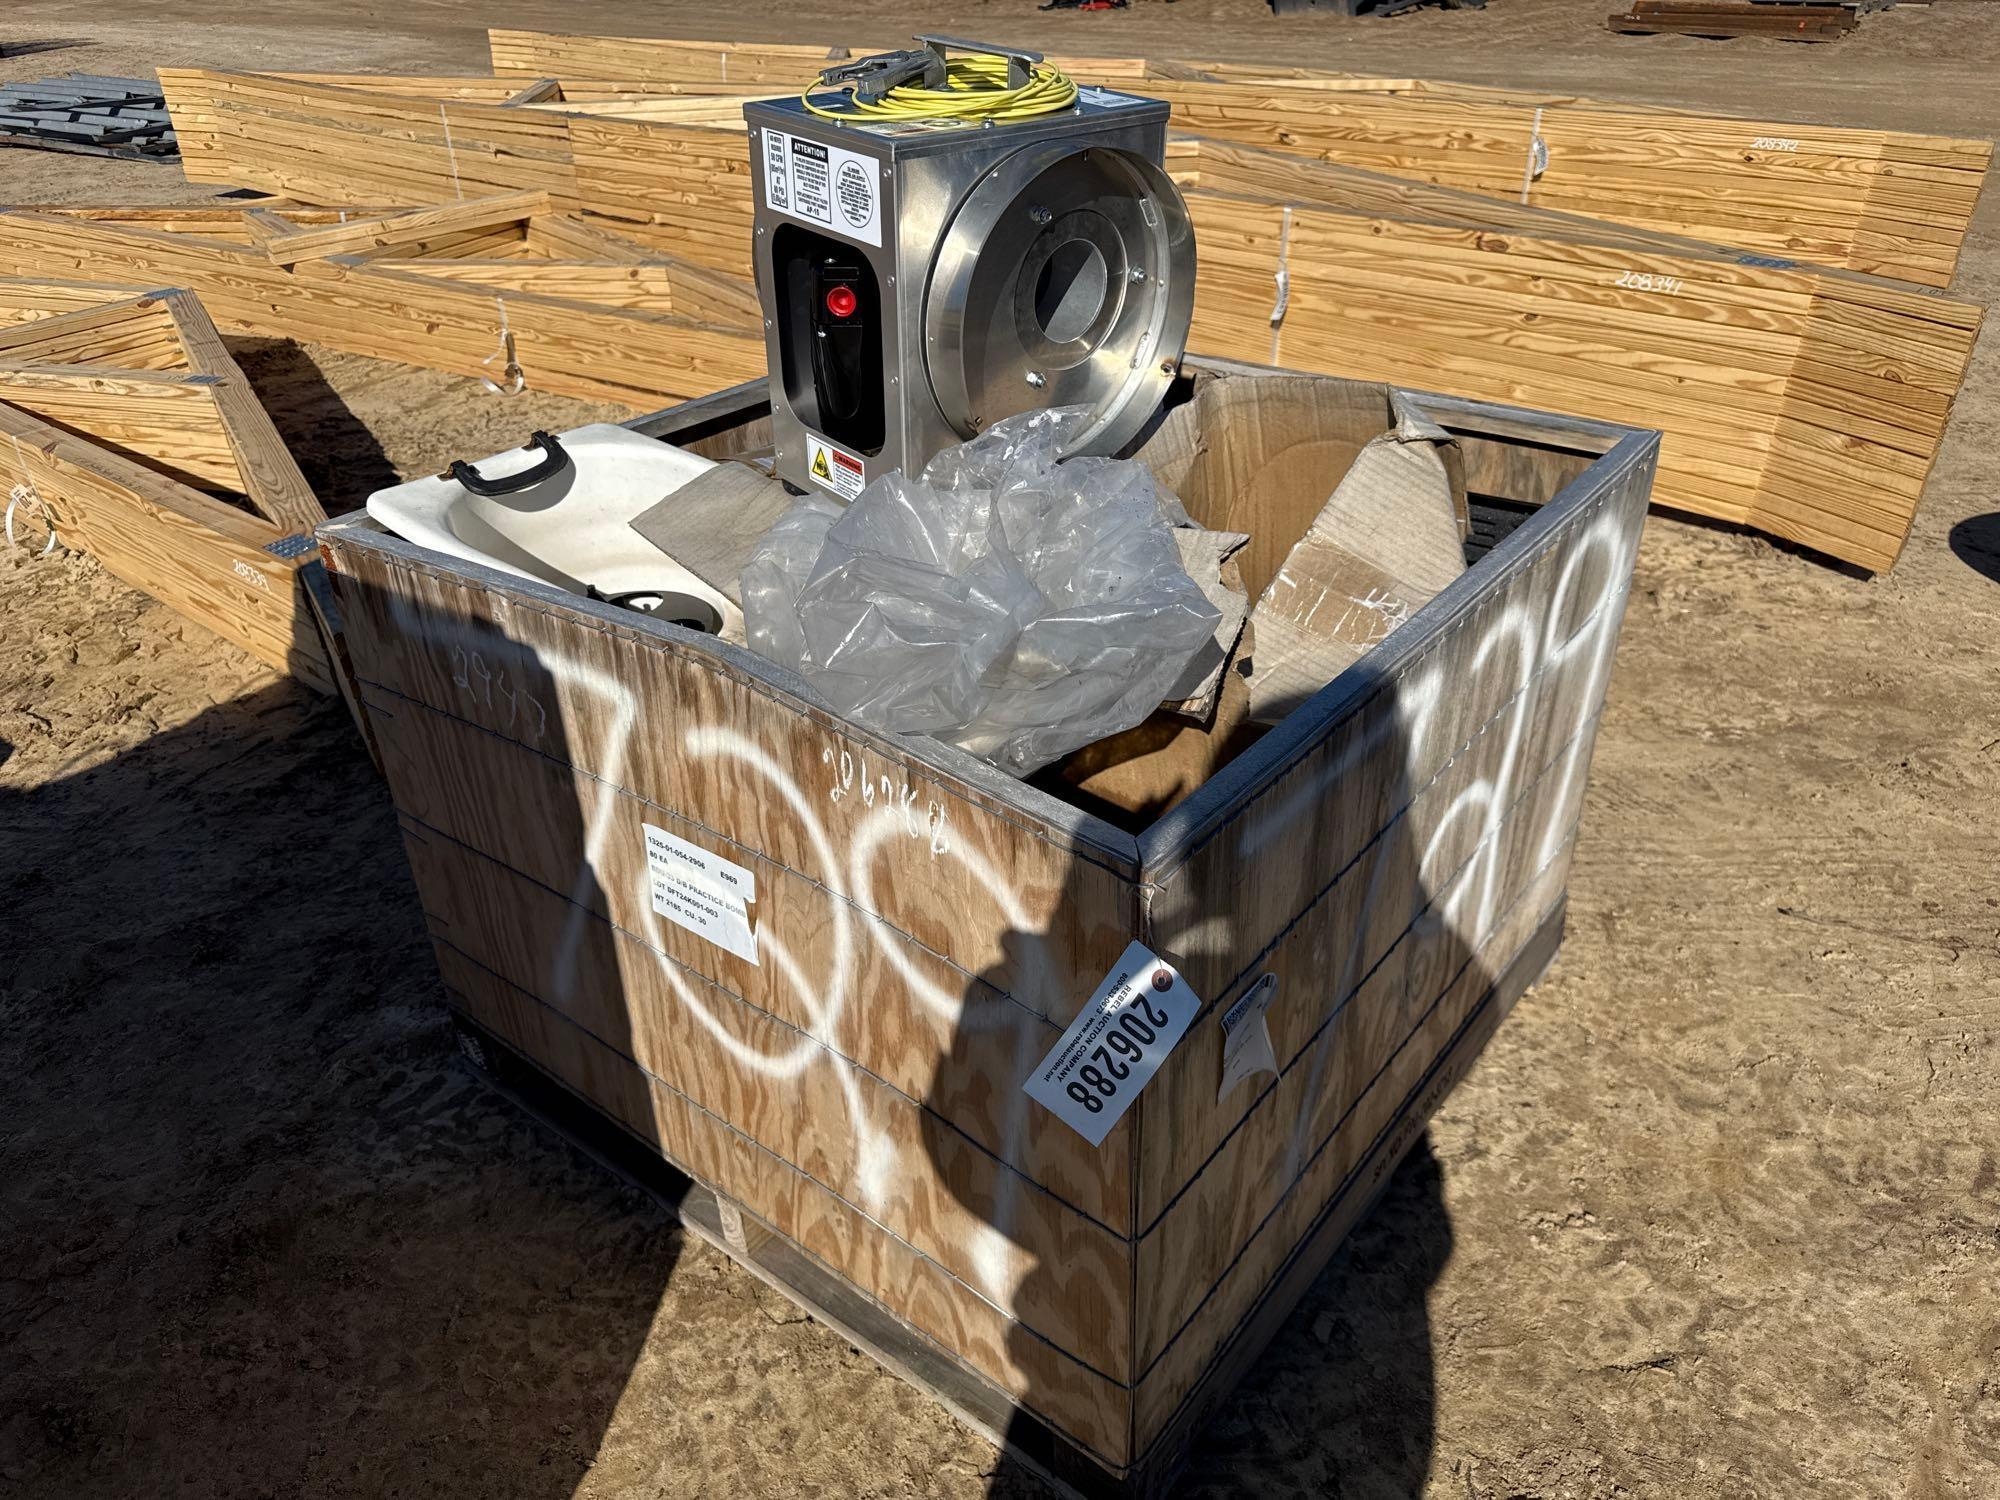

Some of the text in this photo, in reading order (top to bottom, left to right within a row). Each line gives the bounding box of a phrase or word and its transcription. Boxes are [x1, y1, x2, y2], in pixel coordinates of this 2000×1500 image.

[794, 142, 827, 160] ATTENTION!
[1615, 270, 1684, 296] 208341
[647, 836, 738, 885] 1325-01-054-2906 E969
[659, 854, 669, 865] EA
[654, 892, 664, 903] WT
[688, 885, 724, 907] PRACTICE
[1057, 984, 1132, 1083] REBEL AUCTION COMPANY
[1043, 1016, 1096, 1083] www.rebelauction.net
[1066, 992, 1169, 1114] 206288
